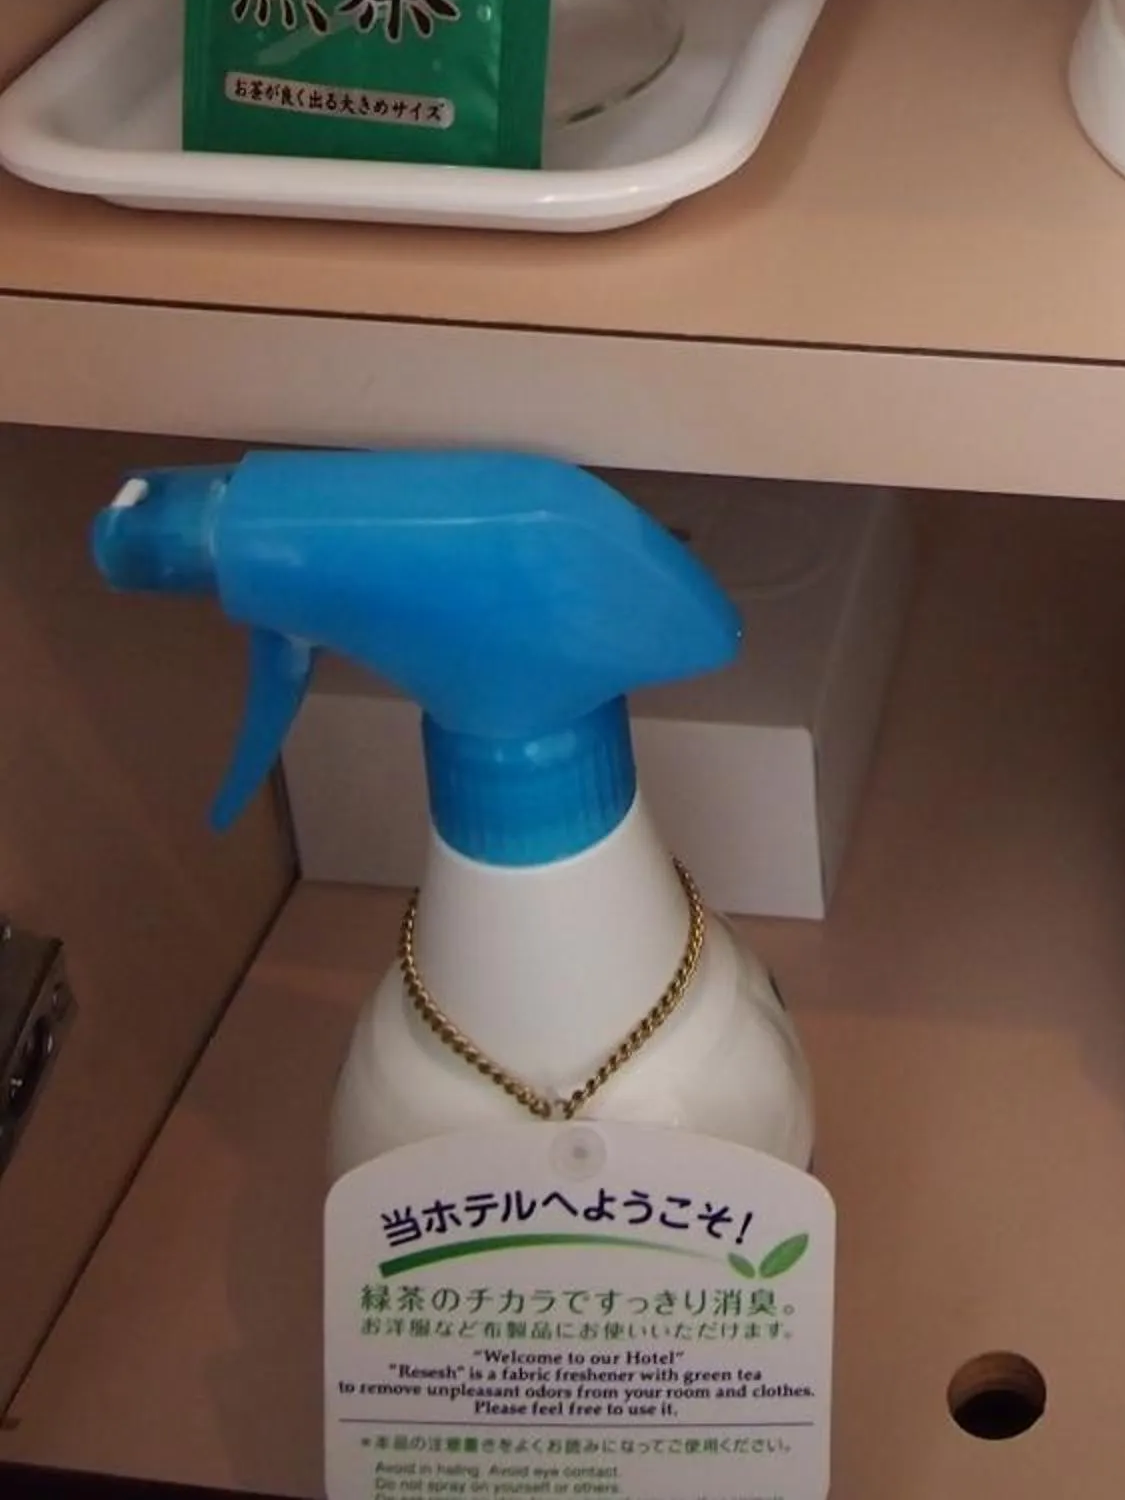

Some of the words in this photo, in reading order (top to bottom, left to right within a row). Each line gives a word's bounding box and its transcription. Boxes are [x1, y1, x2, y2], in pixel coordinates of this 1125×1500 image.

[233, 78, 443, 122] お茶が良く出る大きめサイズ
[361, 1284, 796, 1318] 緑茶のチカラですっきり消臭。
[361, 1318, 794, 1341] お洋服など布製品にお使いいただけます。
[567, 1352, 585, 1365] to
[590, 1354, 620, 1365] our
[469, 1366, 483, 1380] is
[487, 1370, 497, 1380] a
[501, 1367, 550, 1382] fabric
[555, 1367, 635, 1382] freshener
[640, 1368, 678, 1382] with
[683, 1371, 732, 1385] green
[737, 1369, 762, 1381] tea
[338, 1380, 355, 1394] to
[360, 1383, 421, 1396] remove
[426, 1381, 520, 1401] unpleasant
[525, 1383, 572, 1398] odors
[577, 1384, 619, 1399] from
[624, 1386, 661, 1401] your
[667, 1386, 711, 1398] room
[715, 1384, 747, 1398] and
[752, 1383, 815, 1398] clothes.
[474, 1402, 527, 1415] Please
[532, 1401, 563, 1416] feel
[568, 1401, 602, 1416] free
[607, 1403, 624, 1415] to
[628, 1404, 657, 1416] use
[661, 1402, 678, 1417] it.
[490, 1463, 529, 1477] Avoid
[533, 1467, 559, 1479] eye
[400, 1480, 422, 1492] not
[427, 1481, 465, 1495] spray
[470, 1484, 489, 1493] on
[494, 1480, 550, 1495] yourself
[554, 1484, 568, 1494] or
